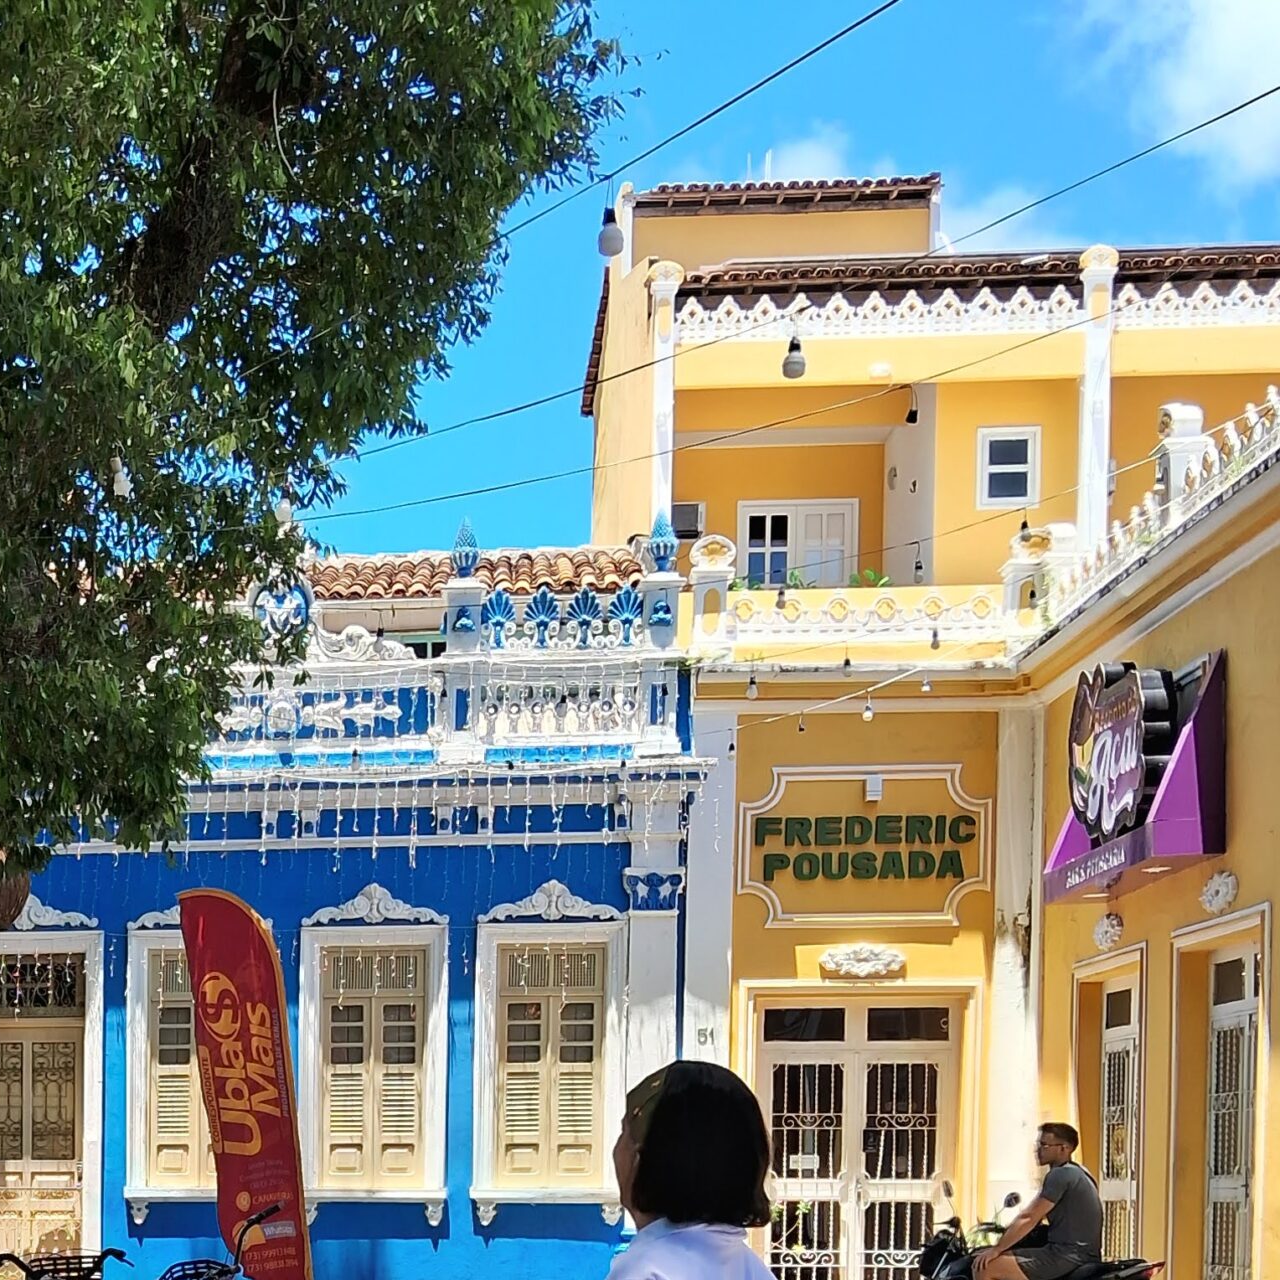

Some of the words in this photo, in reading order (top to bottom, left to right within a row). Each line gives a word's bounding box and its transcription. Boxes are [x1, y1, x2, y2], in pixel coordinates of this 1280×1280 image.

[754, 815, 977, 847] FREDERIC
[763, 850, 965, 882] POUSADA
[246, 1001, 282, 1118] Mais
[697, 1027, 715, 1047] 51
[201, 1056, 221, 1144] CORRESPONDENTE
[214, 1041, 263, 1157] Ubla
[277, 1060, 290, 1117] PROMOTORA
